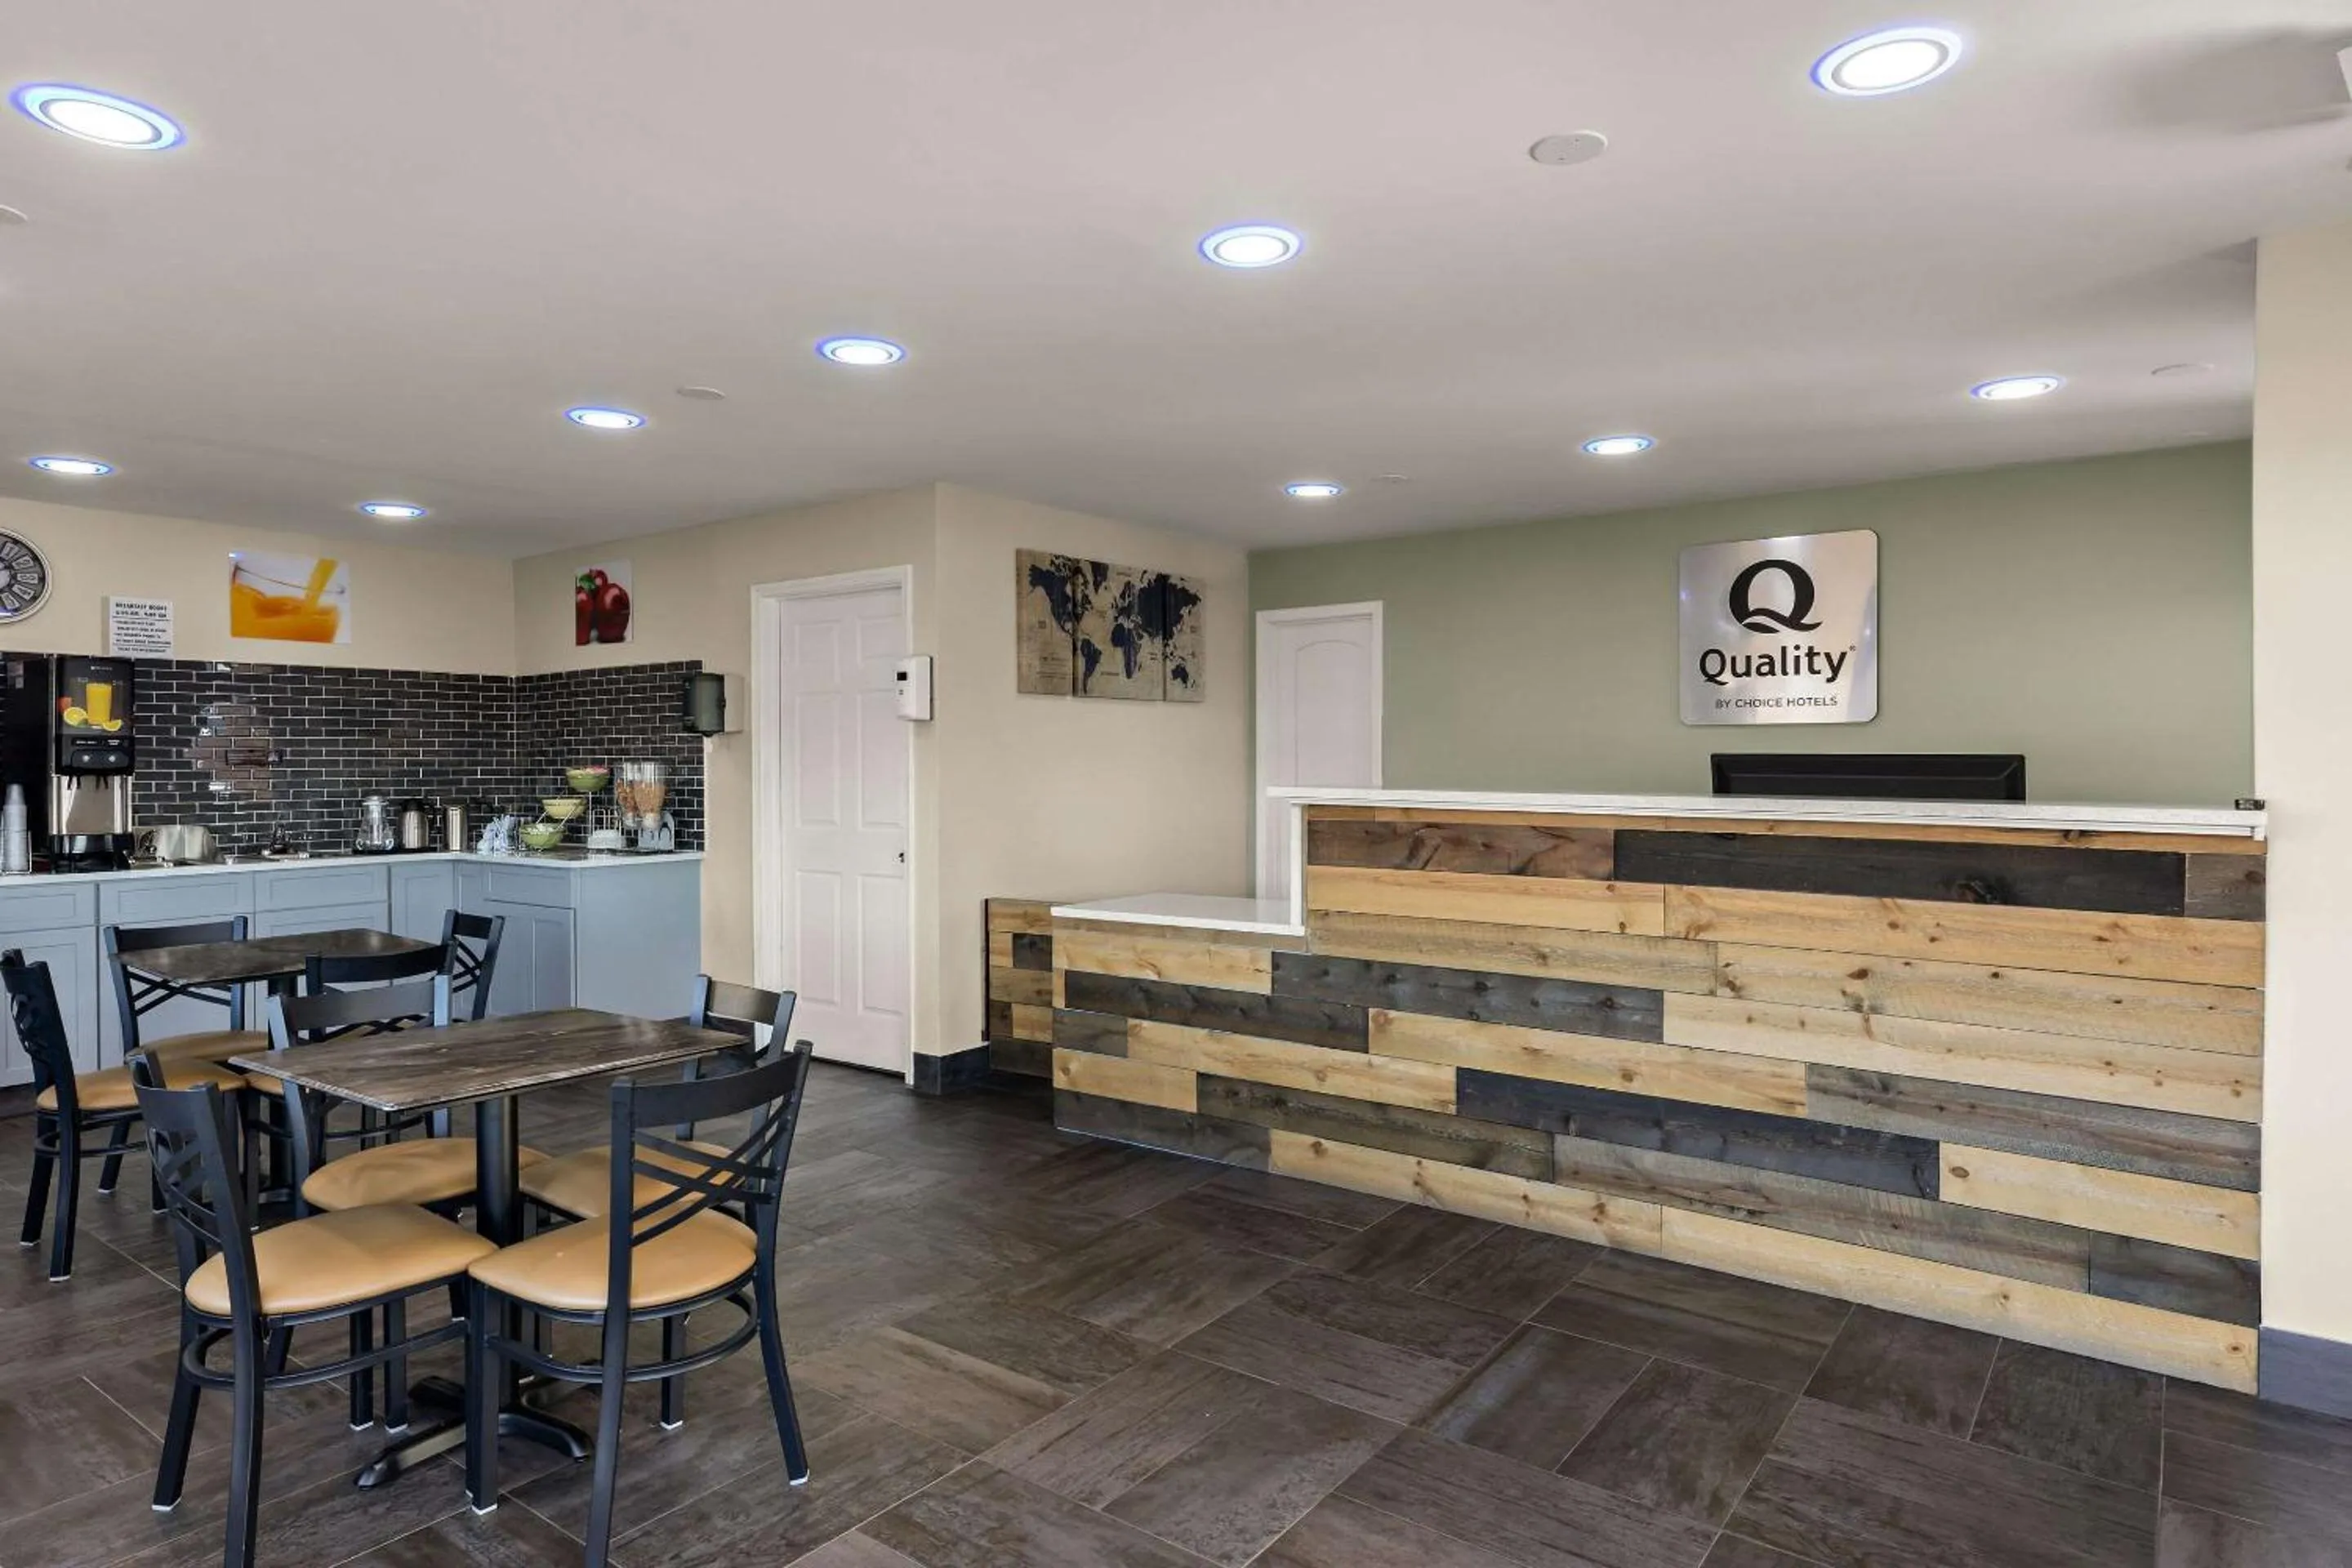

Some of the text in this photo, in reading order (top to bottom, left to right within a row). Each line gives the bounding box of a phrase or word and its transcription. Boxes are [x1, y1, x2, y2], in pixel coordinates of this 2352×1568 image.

[1729, 559, 1824, 635] Q
[1699, 644, 1848, 686] Quality
[1716, 696, 1838, 709] BY CHOICE HOTELS
